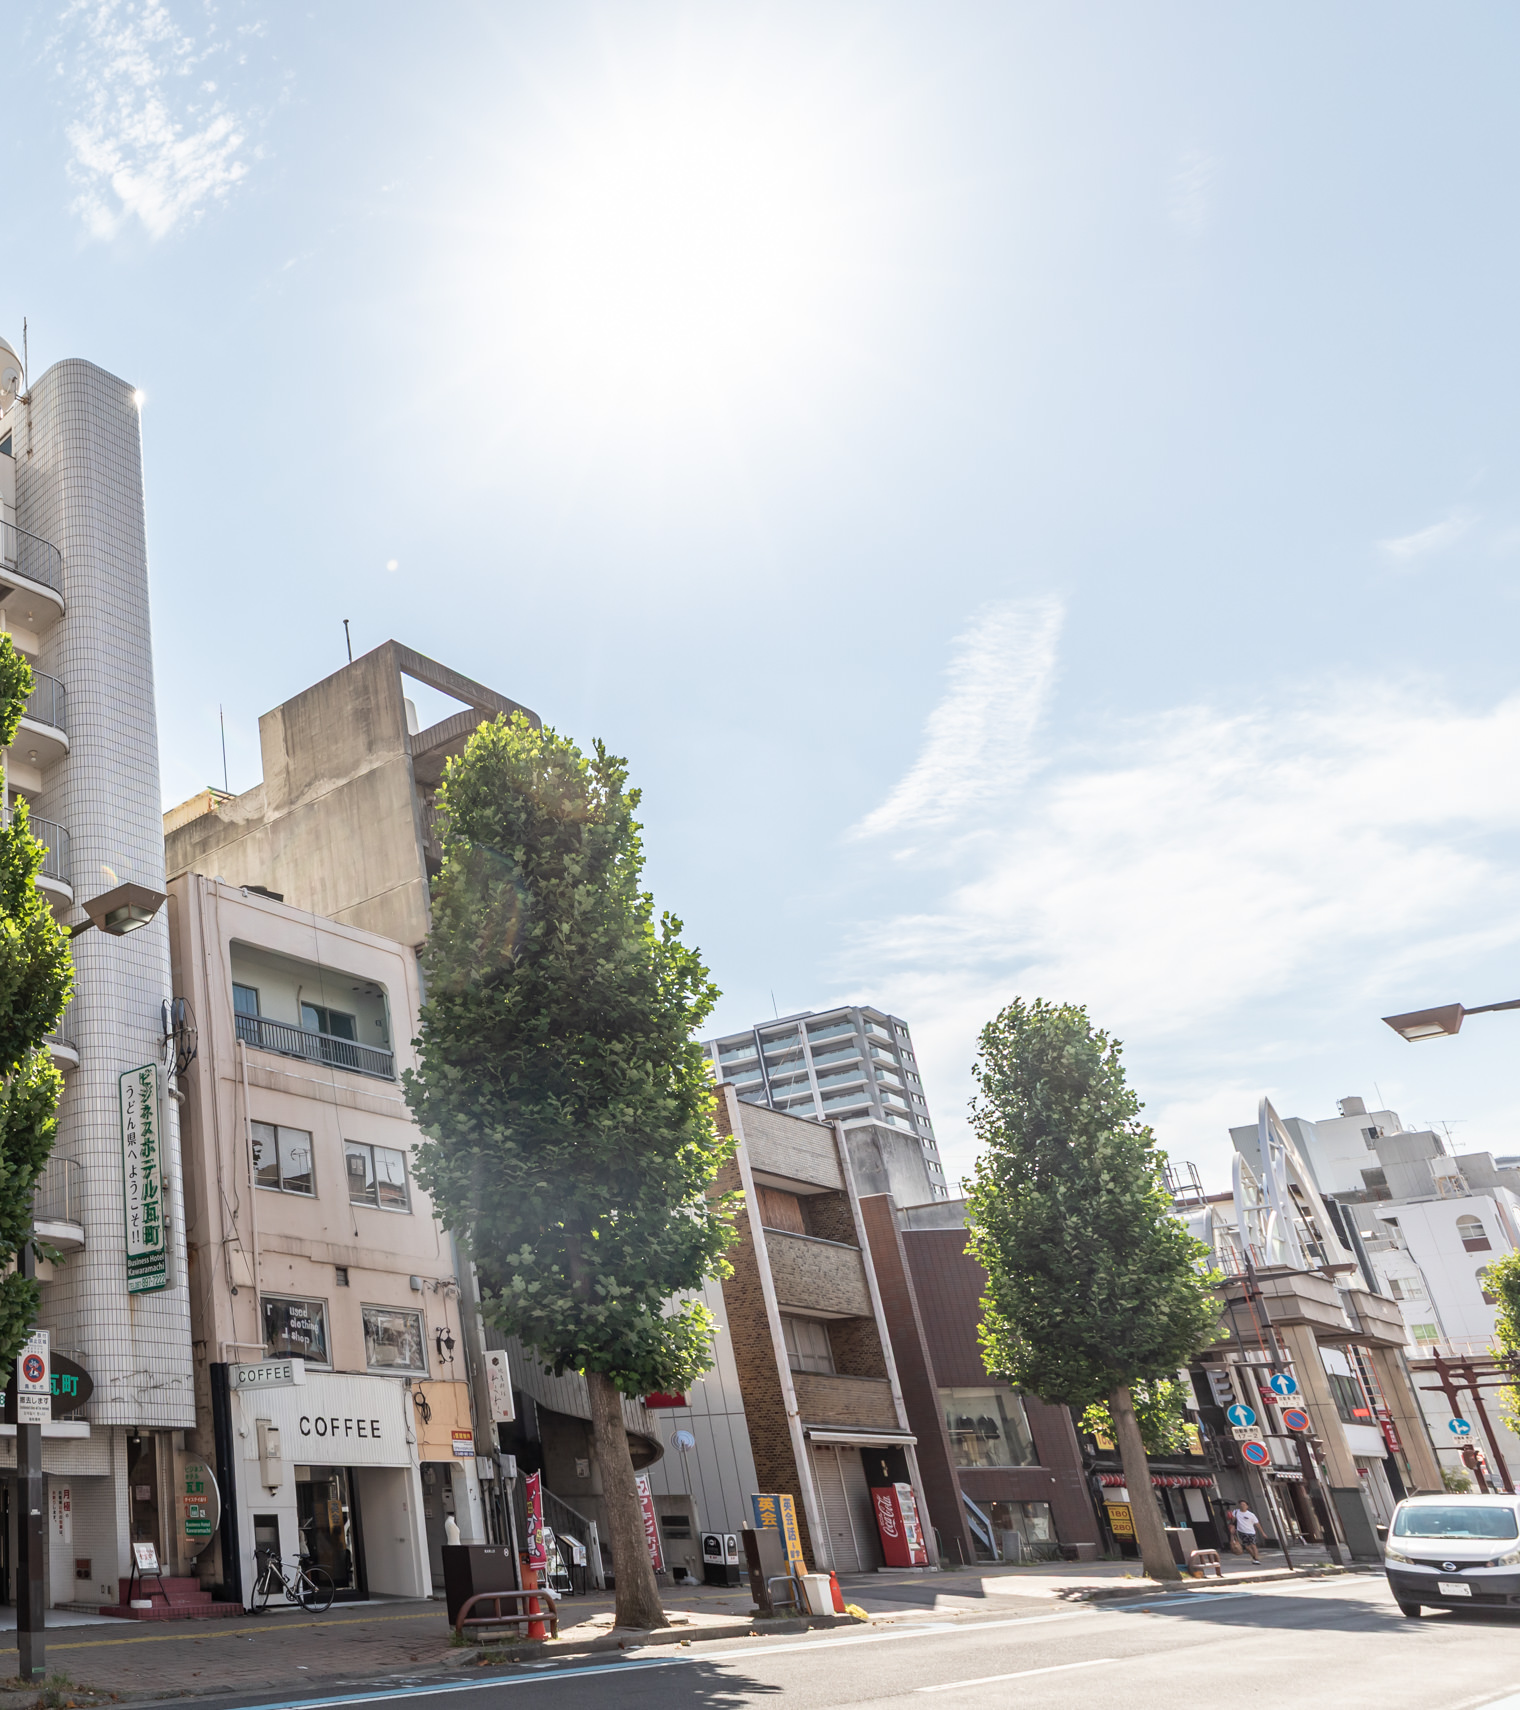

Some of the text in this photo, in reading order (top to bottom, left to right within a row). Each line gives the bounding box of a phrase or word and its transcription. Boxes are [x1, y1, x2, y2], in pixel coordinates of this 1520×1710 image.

[139, 1068, 160, 1246] ビジネスホテル瓦町
[128, 1257, 150, 1267] Business
[128, 1262, 165, 1277] Kawaramachi
[289, 1303, 308, 1317] used
[290, 1317, 320, 1335] clothing
[291, 1331, 310, 1345] shop
[238, 1366, 291, 1383] COFFEE
[299, 1416, 381, 1438] COFFEE
[185, 1481, 204, 1494] 瓦町
[757, 1497, 778, 1529] 英会
[782, 1498, 797, 1541] 英会話
